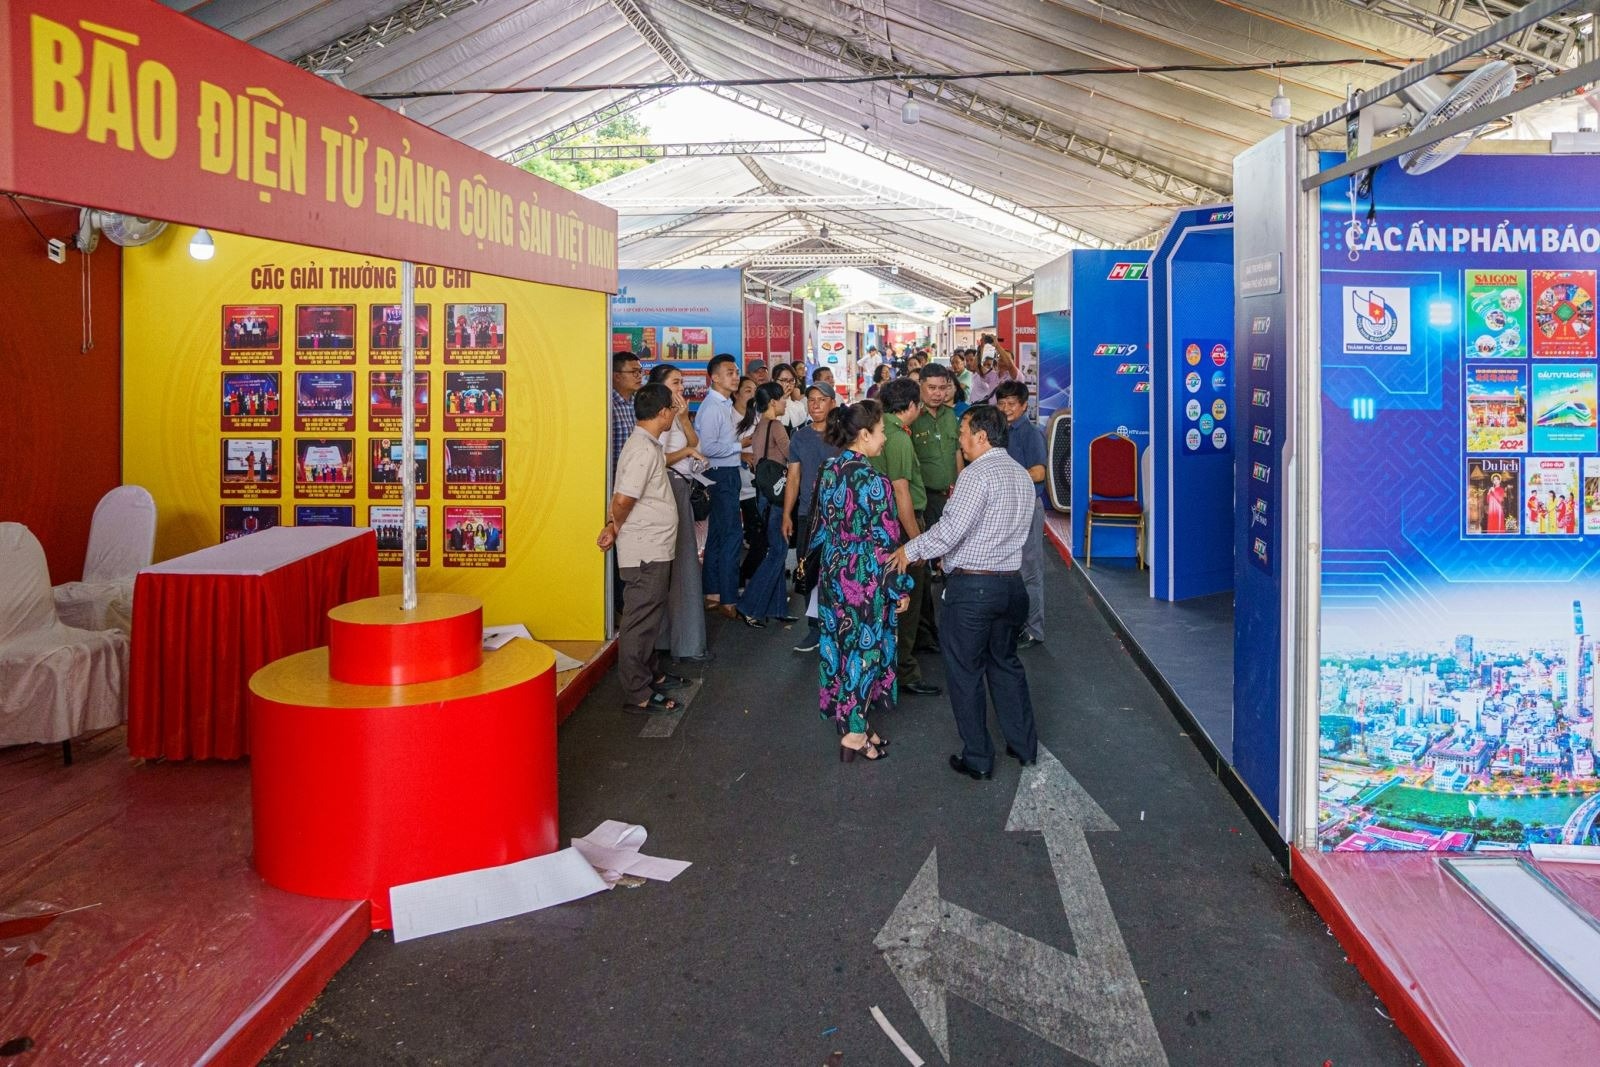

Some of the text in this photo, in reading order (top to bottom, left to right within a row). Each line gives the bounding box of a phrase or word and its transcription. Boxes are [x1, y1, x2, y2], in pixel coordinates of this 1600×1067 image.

[197, 80, 307, 203] ĐIỆN
[320, 115, 368, 208] TỬ
[374, 138, 450, 231] ĐẢNG
[458, 174, 513, 249] CỘNG
[518, 192, 552, 255] SẢN
[555, 209, 584, 270] VIỆT
[587, 223, 615, 270] NAM
[1345, 220, 1600, 253] CÁC ẤN PHẨM BÁO
[251, 264, 284, 289] CÁC
[290, 261, 323, 289] GIẢI
[329, 261, 397, 289] THƯỞNG
[1108, 263, 1149, 280] HT
[1094, 344, 1137, 356] HTV9
[1500, 440, 1523, 449] 2024
[1482, 460, 1498, 471] Du
